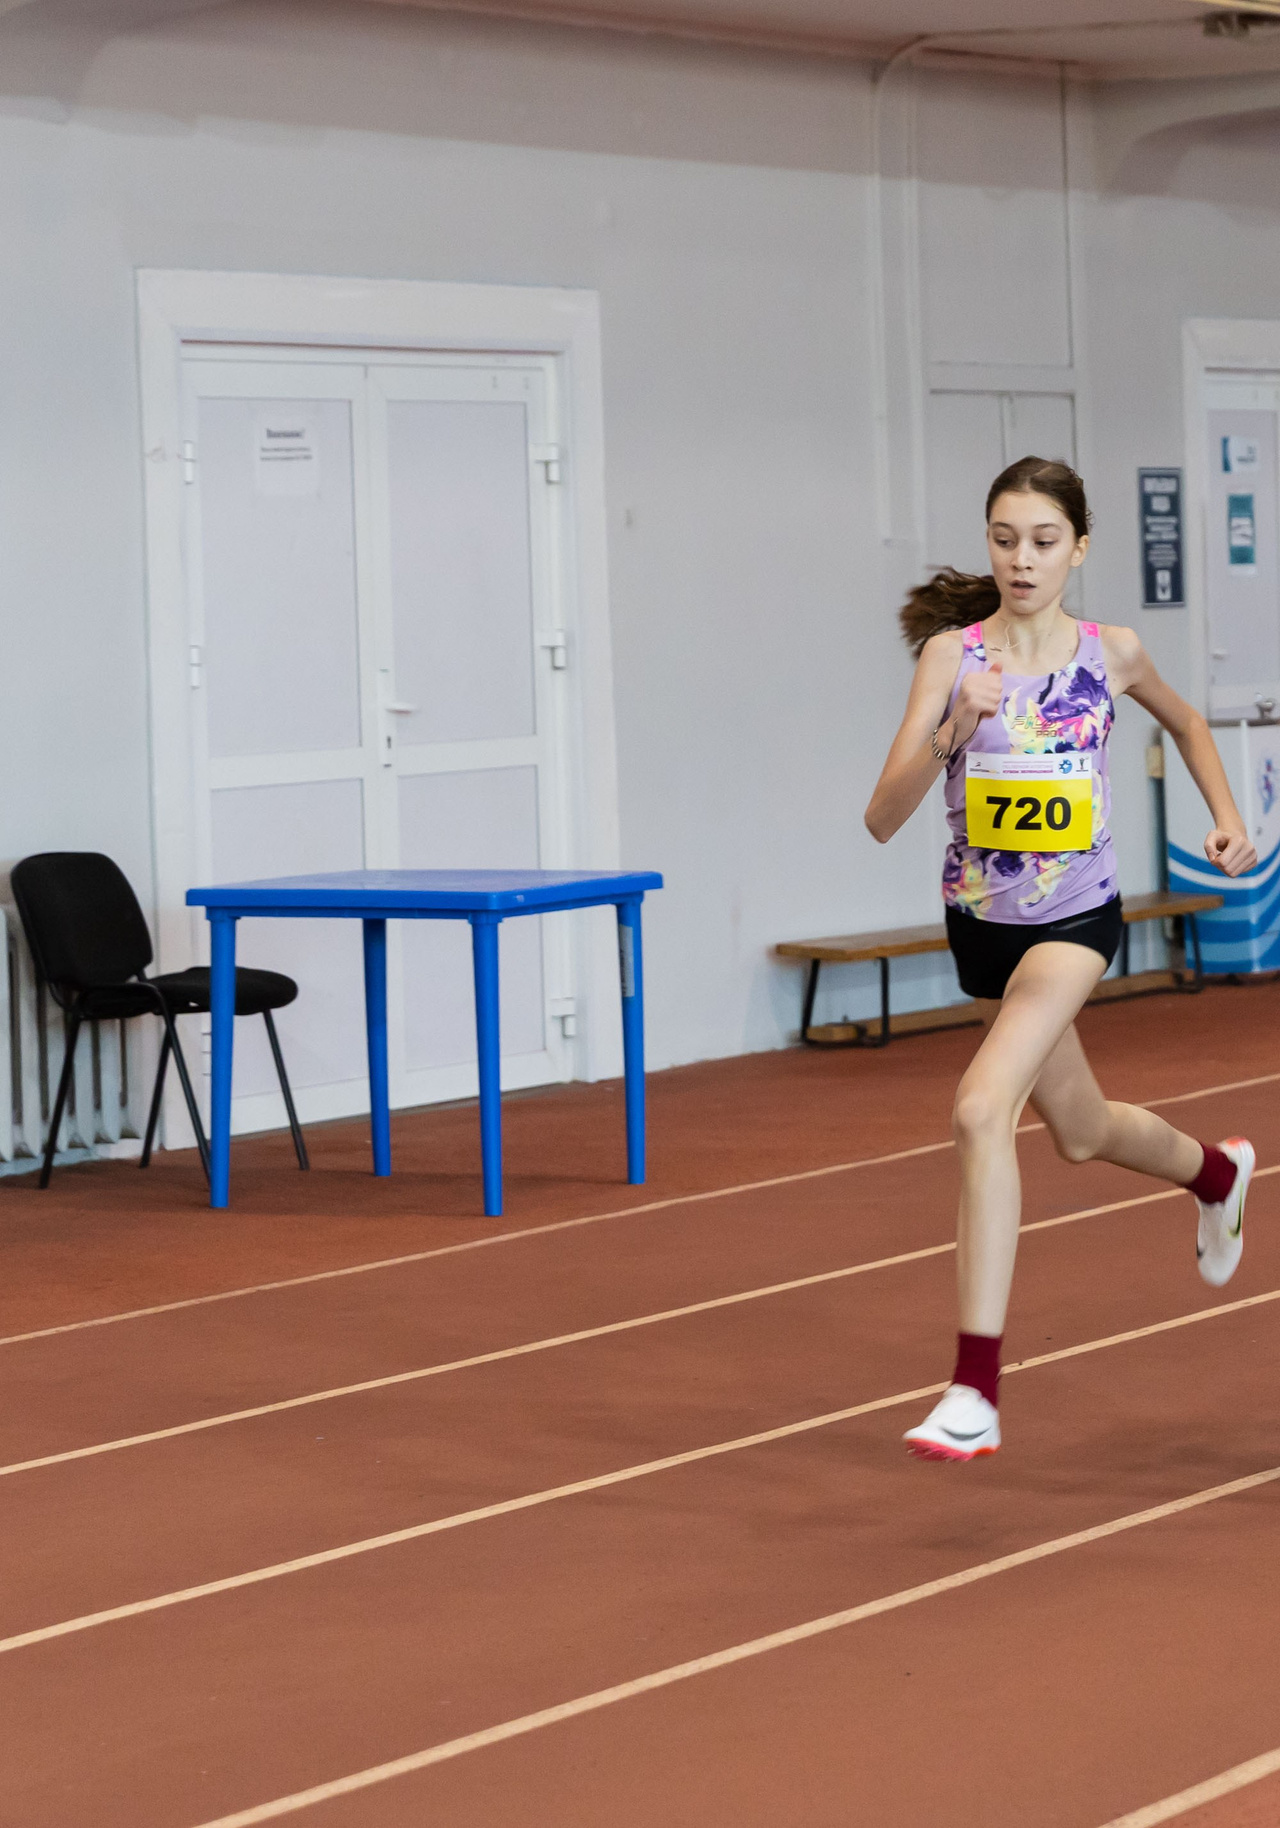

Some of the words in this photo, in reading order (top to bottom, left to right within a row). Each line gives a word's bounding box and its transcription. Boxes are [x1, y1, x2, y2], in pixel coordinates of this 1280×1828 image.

[1010, 715, 1056, 729] FILA
[1036, 730, 1057, 738] PRO
[986, 796, 1072, 831] 720
